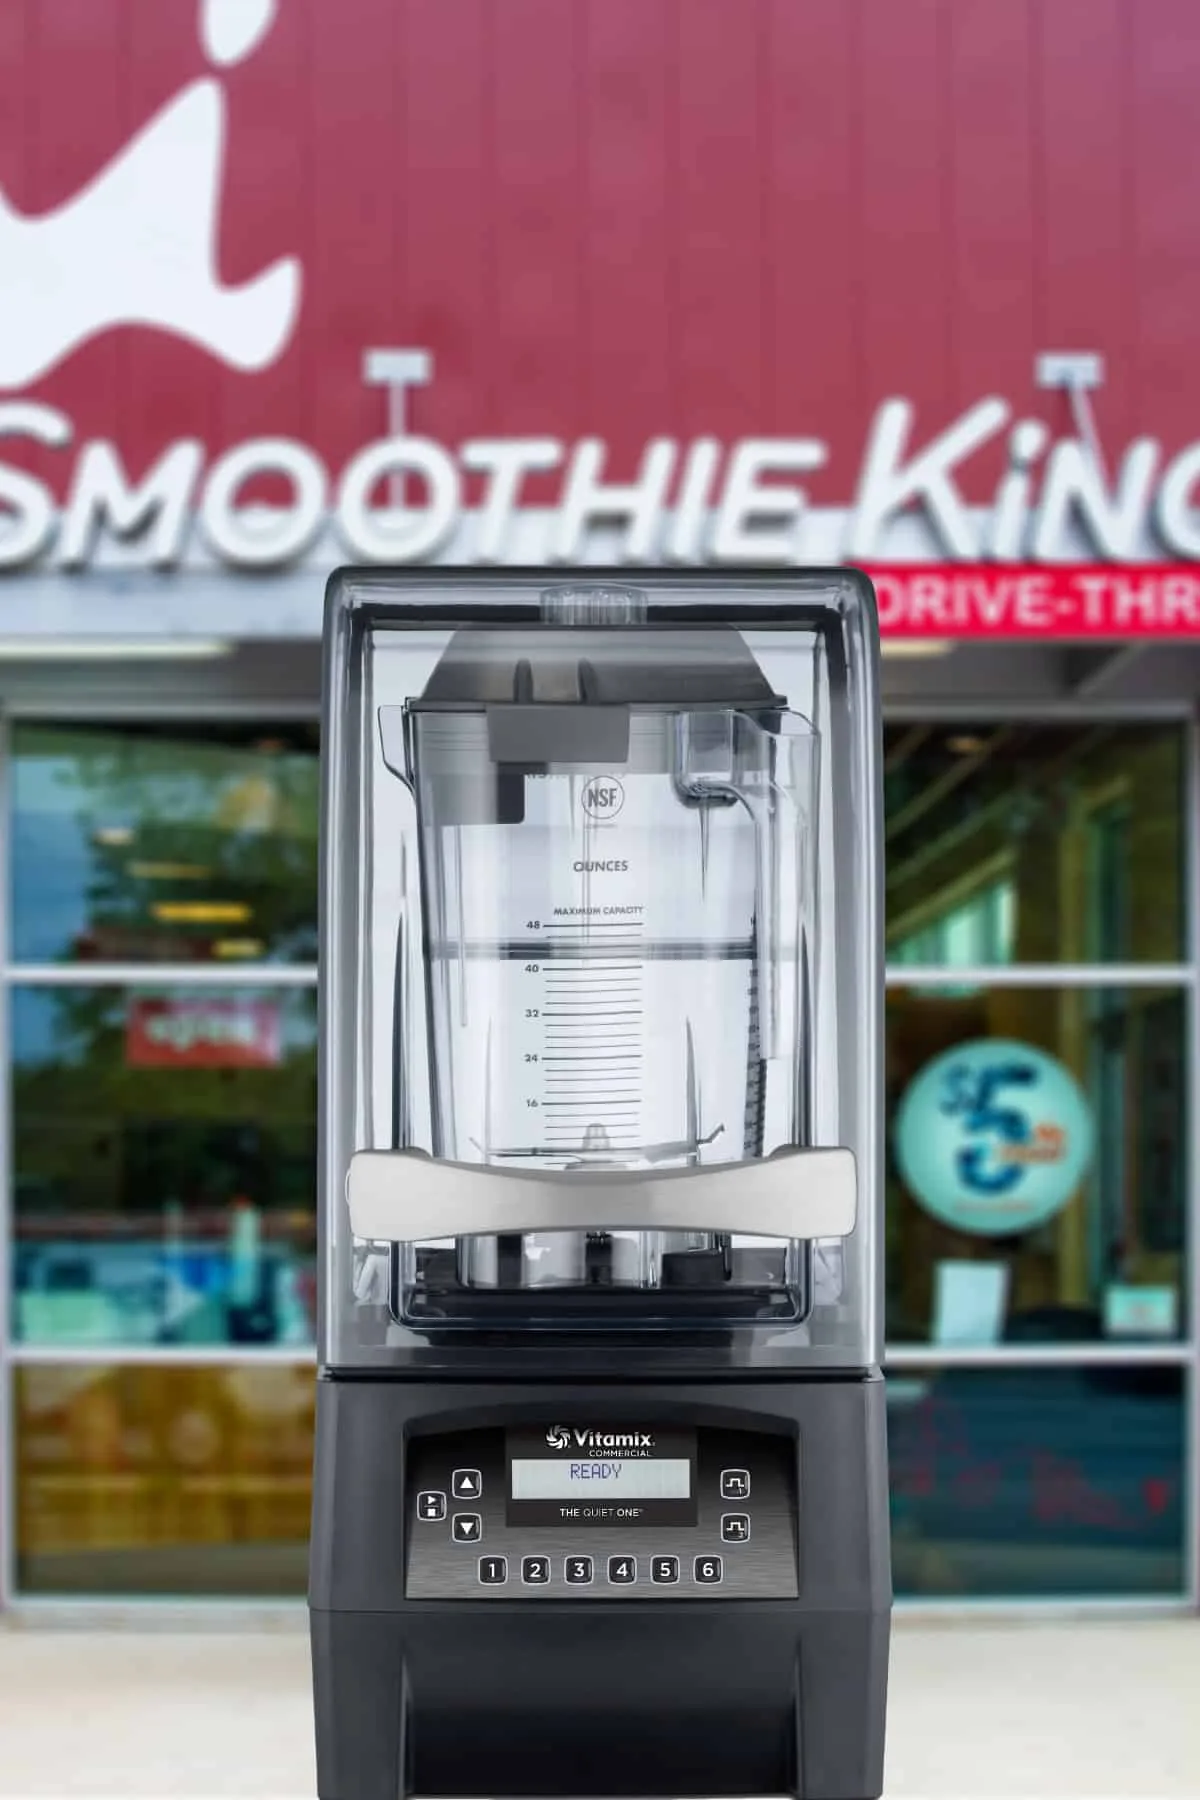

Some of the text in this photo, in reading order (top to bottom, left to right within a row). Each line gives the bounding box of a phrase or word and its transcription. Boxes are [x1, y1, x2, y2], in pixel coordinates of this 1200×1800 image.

[0, 401, 827, 566] SMOOTHIE
[587, 787, 618, 808] NSF
[573, 860, 629, 873] OUNCES
[553, 905, 644, 916] MAXIMUM CAPACITY
[526, 920, 541, 930] 48
[525, 963, 540, 974] 40
[525, 1008, 540, 1019] 32
[525, 1053, 539, 1063] 24
[526, 1098, 539, 1108] 16
[574, 1428, 653, 1447] Vitamix
[589, 1449, 652, 1458] COMMERCIAL
[570, 1463, 622, 1480] READY
[560, 1508, 640, 1518] THE QUIET ONE
[488, 1563, 496, 1578] 1
[530, 1563, 541, 1578] 2
[574, 1563, 584, 1578] 3
[616, 1563, 628, 1578] 4
[660, 1563, 670, 1578] 5
[703, 1563, 714, 1578] 6
